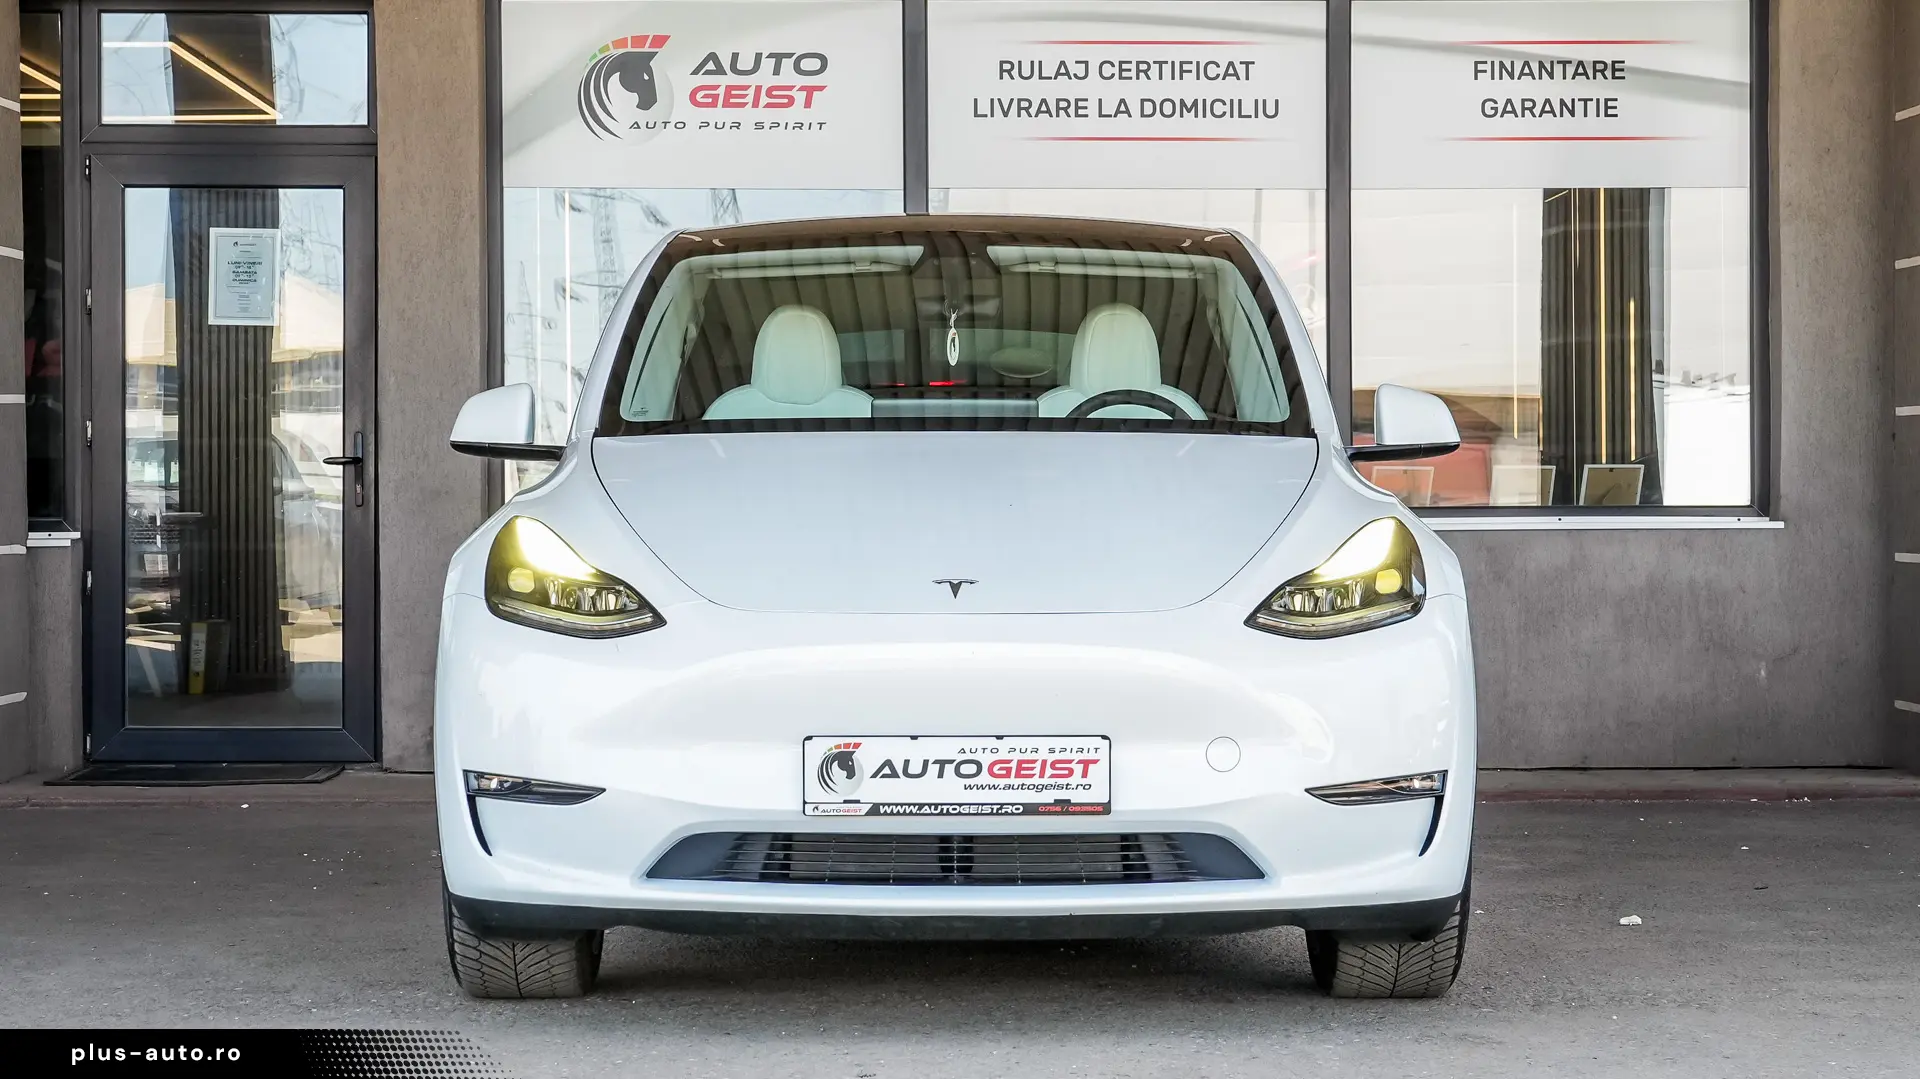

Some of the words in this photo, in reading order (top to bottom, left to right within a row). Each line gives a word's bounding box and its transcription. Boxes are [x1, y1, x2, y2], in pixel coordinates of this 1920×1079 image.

[690, 52, 828, 77] AUTO
[999, 60, 1090, 81] RULAJ
[1098, 60, 1256, 81] CERTIFICAT
[1473, 60, 1626, 81] FINANTARE
[688, 85, 828, 109] GEIST
[973, 98, 1089, 119] LIVRARE
[1097, 98, 1133, 119] LA
[1140, 98, 1280, 119] DOMICILIU
[1480, 98, 1619, 119] GARANTIE
[629, 121, 687, 130] AUTO
[698, 121, 742, 130] PUR
[754, 121, 827, 131] SPIRIT
[957, 747, 1000, 755] AUTO
[964, 782, 1092, 793] www.autogeist.ro
[879, 804, 1024, 815] WWW.AUTOGEIST.RO
